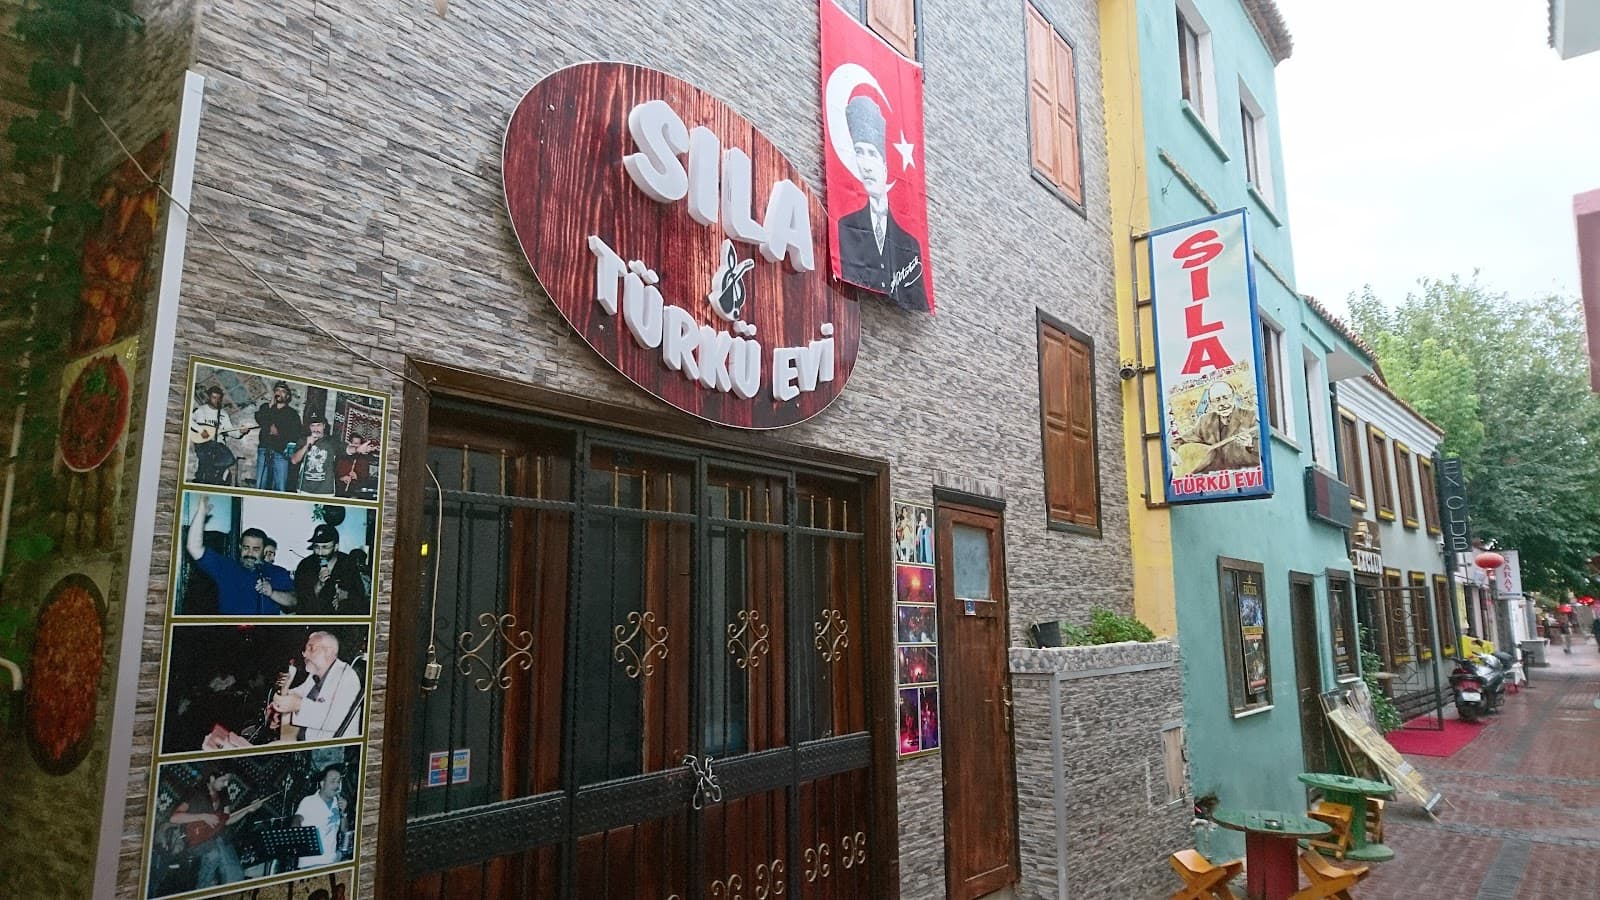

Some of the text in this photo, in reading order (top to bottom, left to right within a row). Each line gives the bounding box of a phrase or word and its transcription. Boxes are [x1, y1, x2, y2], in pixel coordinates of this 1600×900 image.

[622, 99, 815, 273] SILA
[588, 235, 835, 401] TÜRKÜ EVİ
[1172, 229, 1235, 375] SILA
[1172, 470, 1231, 496] TÜRKÜ
[1446, 495, 1468, 551] CLUB
